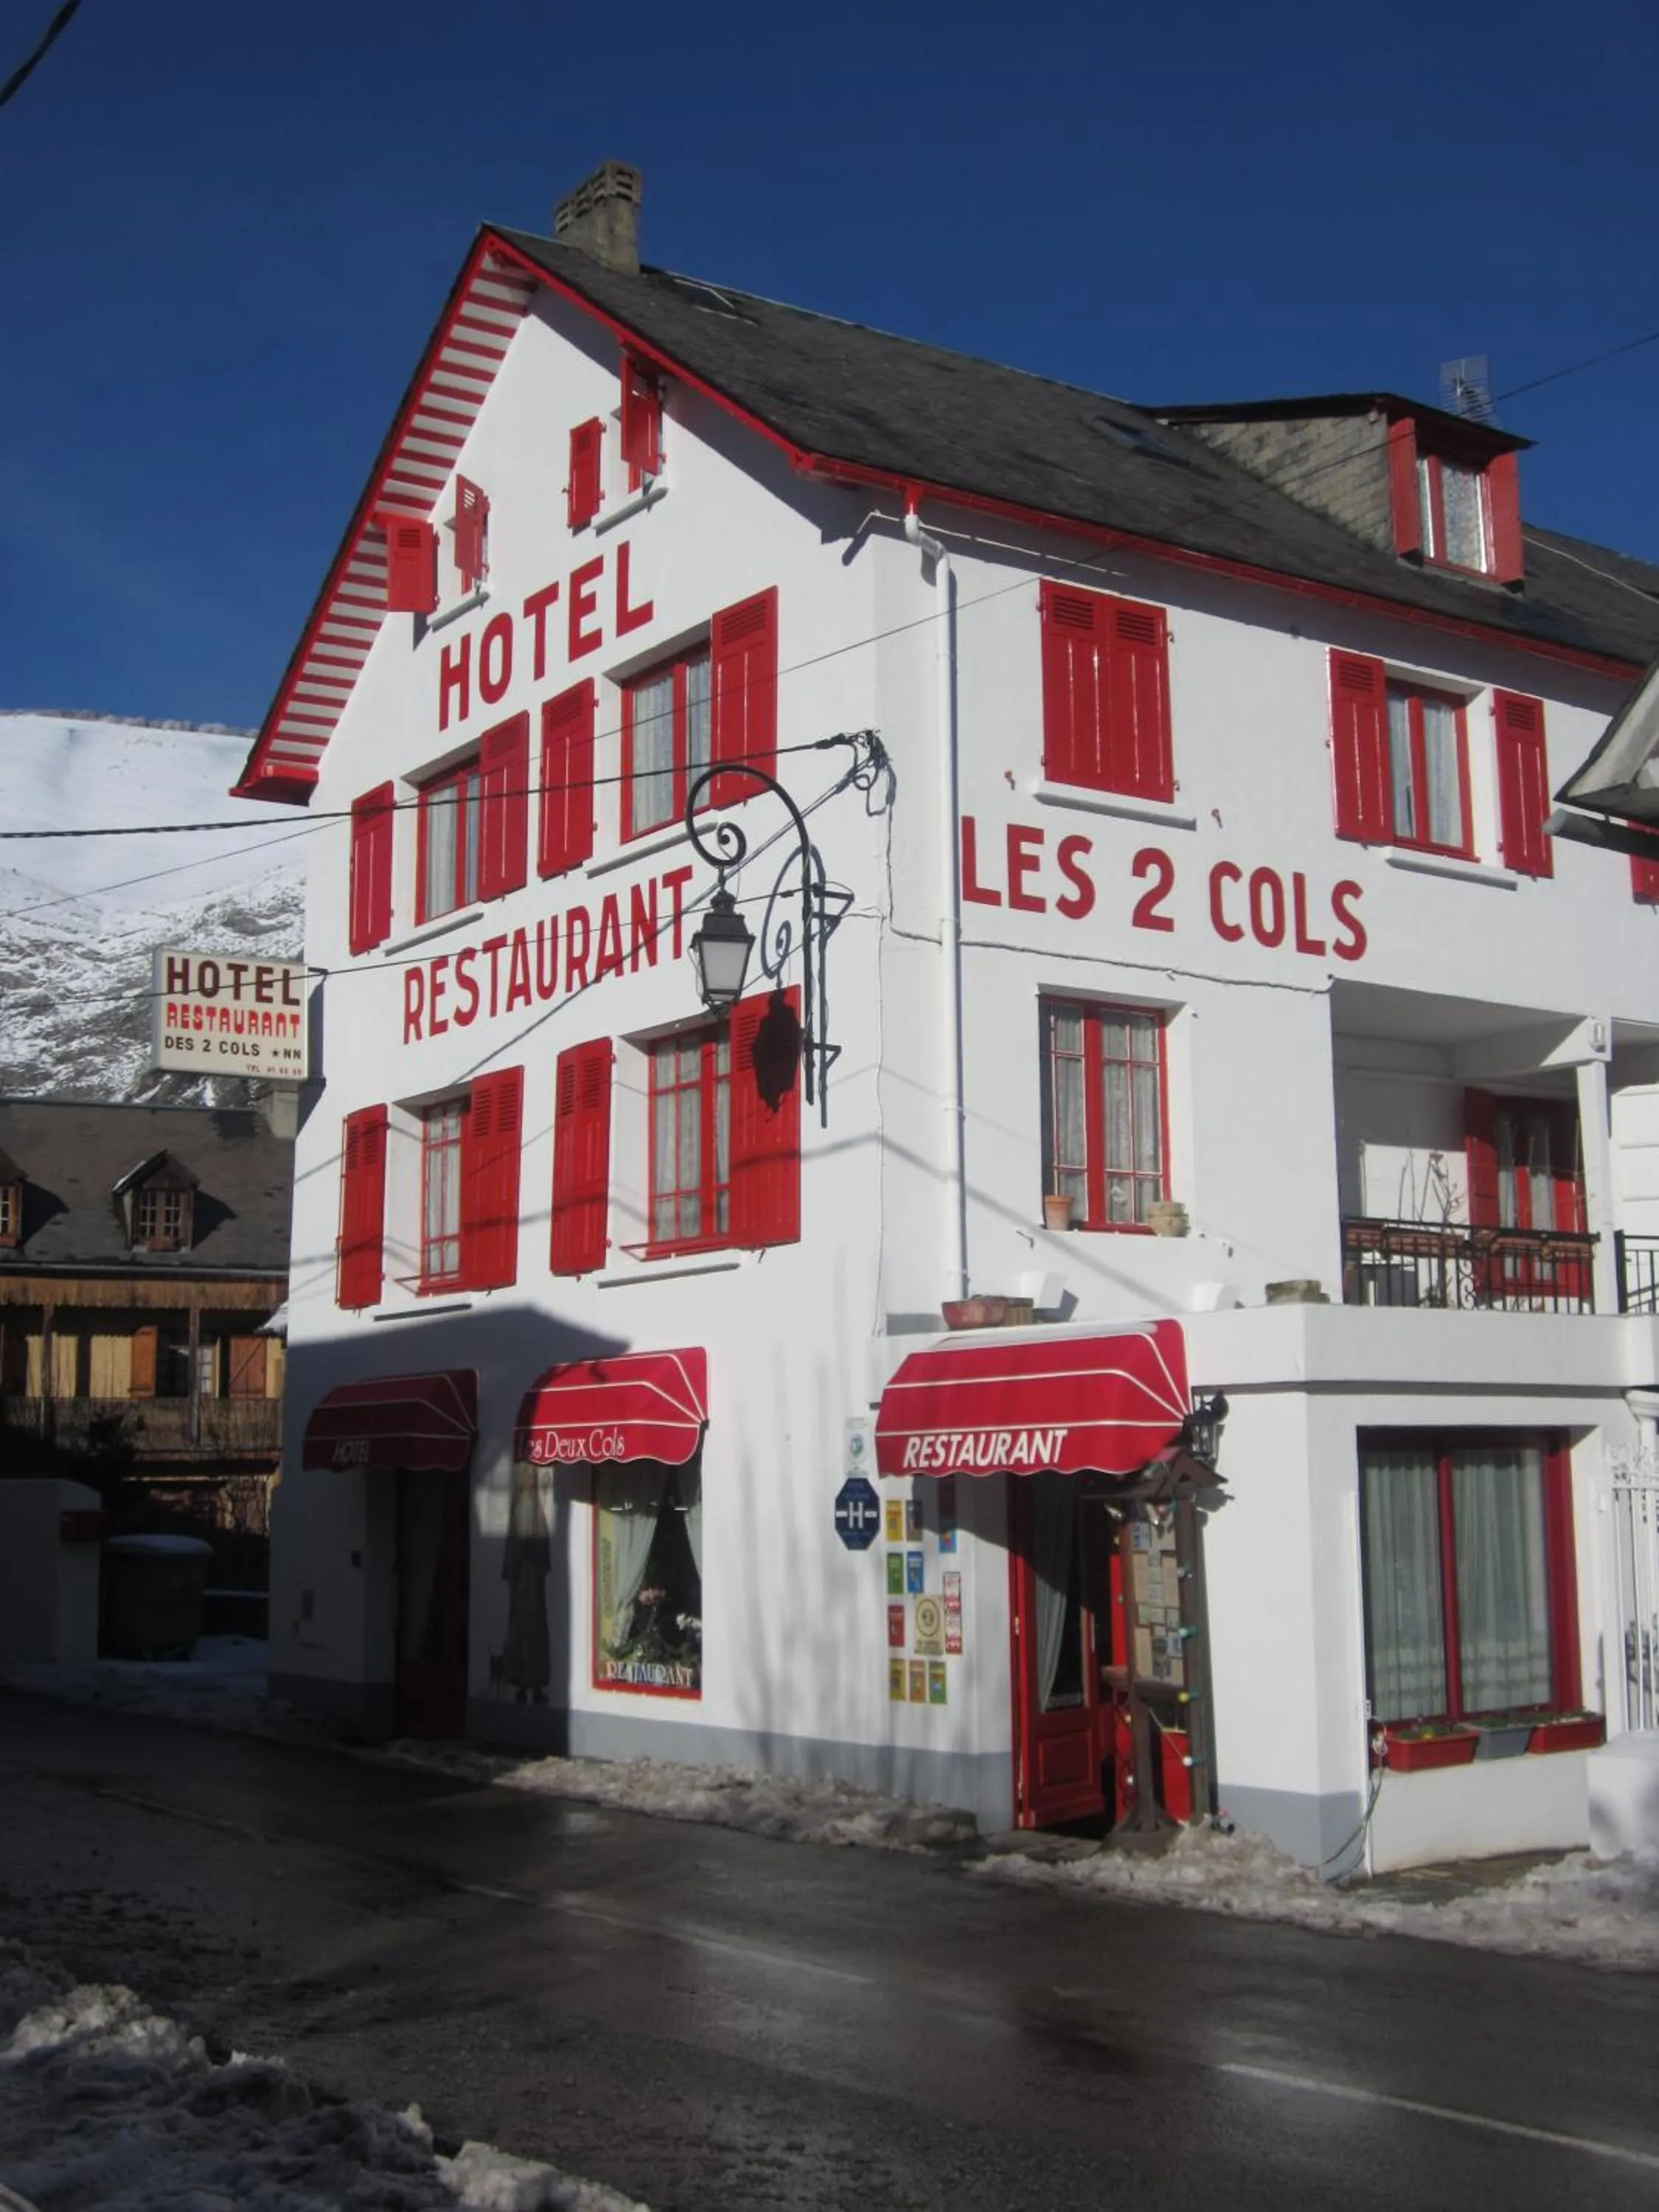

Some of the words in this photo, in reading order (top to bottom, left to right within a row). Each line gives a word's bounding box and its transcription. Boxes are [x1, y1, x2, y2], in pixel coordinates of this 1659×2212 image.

[439, 541, 654, 731] HOTEL
[961, 815, 1096, 919] LES
[1132, 847, 1175, 932] 2
[1209, 860, 1367, 961] COLS
[403, 865, 692, 1045] RESTAURANT
[167, 957, 300, 1006] HOTEL
[167, 1002, 300, 1038] RESTAURANT
[165, 1036, 194, 1050] DES
[203, 1040, 212, 1052] 2
[219, 1041, 260, 1056] COLS
[332, 1439, 371, 1464] HOTEL
[545, 1430, 587, 1458] Deux
[589, 1426, 625, 1457] Cols
[902, 1429, 1068, 1469] RESTAURANT
[849, 1501, 863, 1529] H
